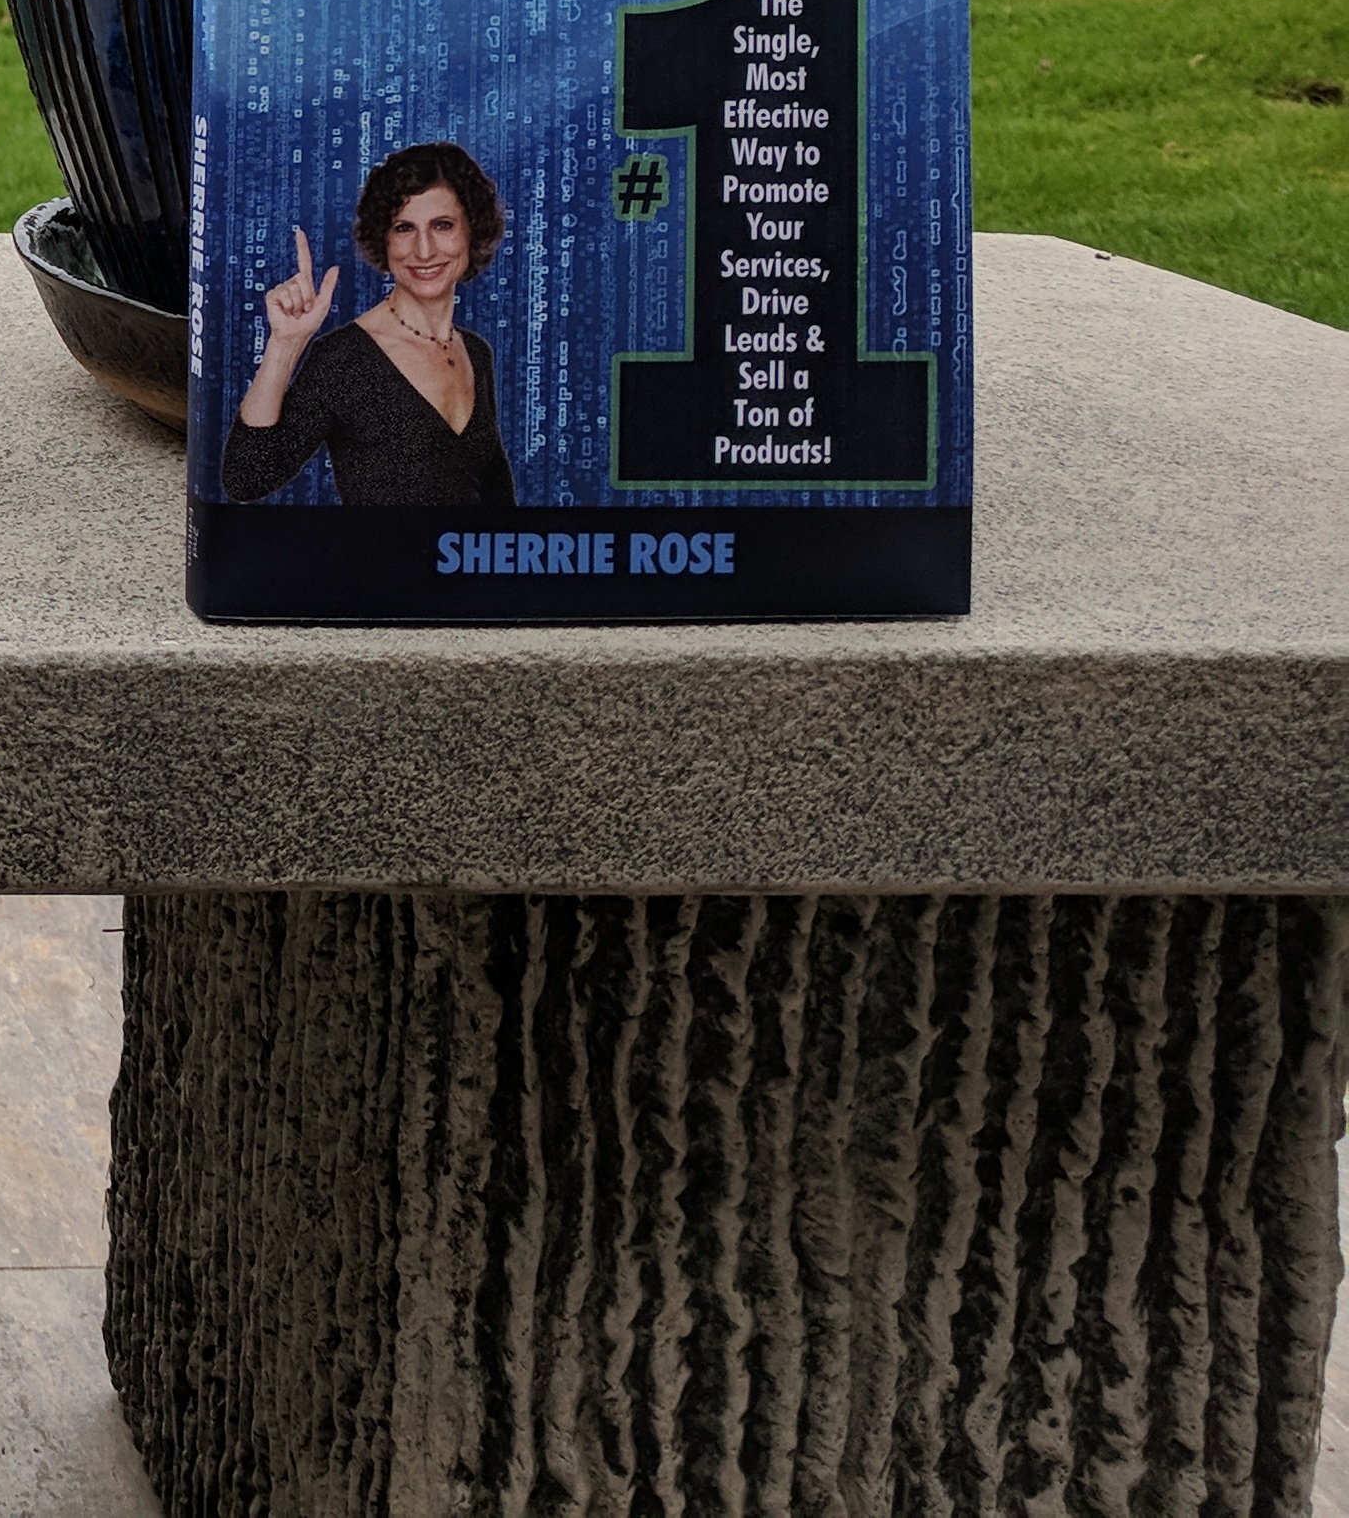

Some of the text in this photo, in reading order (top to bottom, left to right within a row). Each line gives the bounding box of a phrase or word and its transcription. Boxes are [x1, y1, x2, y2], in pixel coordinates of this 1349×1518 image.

[733, 24, 820, 62] Single,
[745, 63, 807, 91] Most
[724, 98, 829, 129] Effective
[731, 137, 820, 173] Way to
[723, 175, 829, 203] Promote
[746, 212, 804, 240] Your
[189, 114, 208, 378] SHERRIE ROSE
[720, 249, 830, 282] Services,
[742, 287, 809, 315] Drive
[725, 322, 825, 352] Leads &
[739, 360, 784, 390] Sell
[733, 397, 814, 427] Ton of
[715, 434, 831, 464] Products!
[436, 533, 735, 576] SHERRIE ROSE
